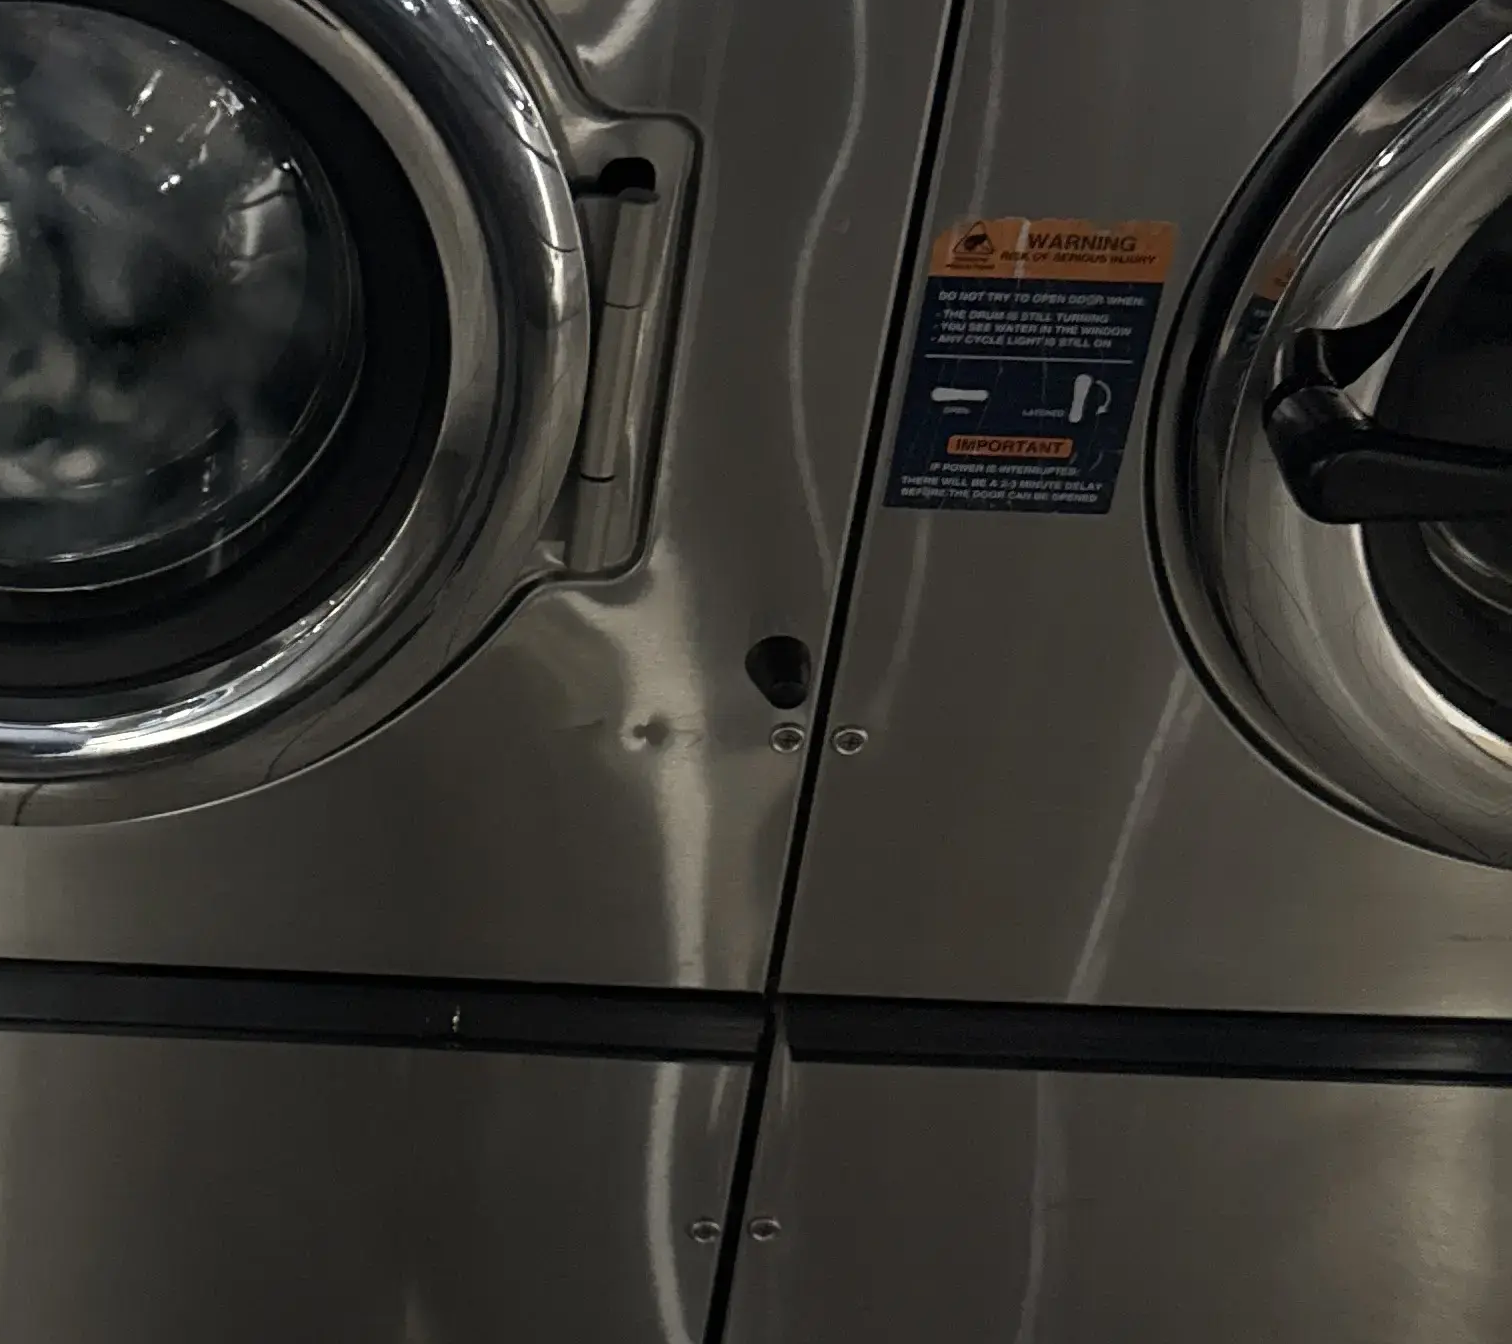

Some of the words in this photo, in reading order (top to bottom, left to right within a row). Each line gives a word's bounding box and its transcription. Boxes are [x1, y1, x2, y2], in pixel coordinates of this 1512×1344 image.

[1026, 232, 1139, 253] WARNING
[1109, 253, 1156, 265] INJURY
[958, 291, 984, 302] NOT
[987, 291, 1011, 303] TRY
[1015, 292, 1031, 304] TO
[1033, 293, 1066, 305] OPEN
[943, 309, 965, 320] THE
[1021, 311, 1052, 323] STILL
[1056, 313, 1109, 324] TURNING
[941, 321, 965, 332] YOU
[995, 323, 1037, 334] WATER
[1056, 325, 1079, 336] THE
[1081, 325, 1133, 337] WINDOW
[964, 335, 1003, 346] CYCLE
[1006, 336, 1042, 347] LIGHT
[1058, 337, 1090, 349] STILL
[955, 437, 1065, 455] IMPORTANT
